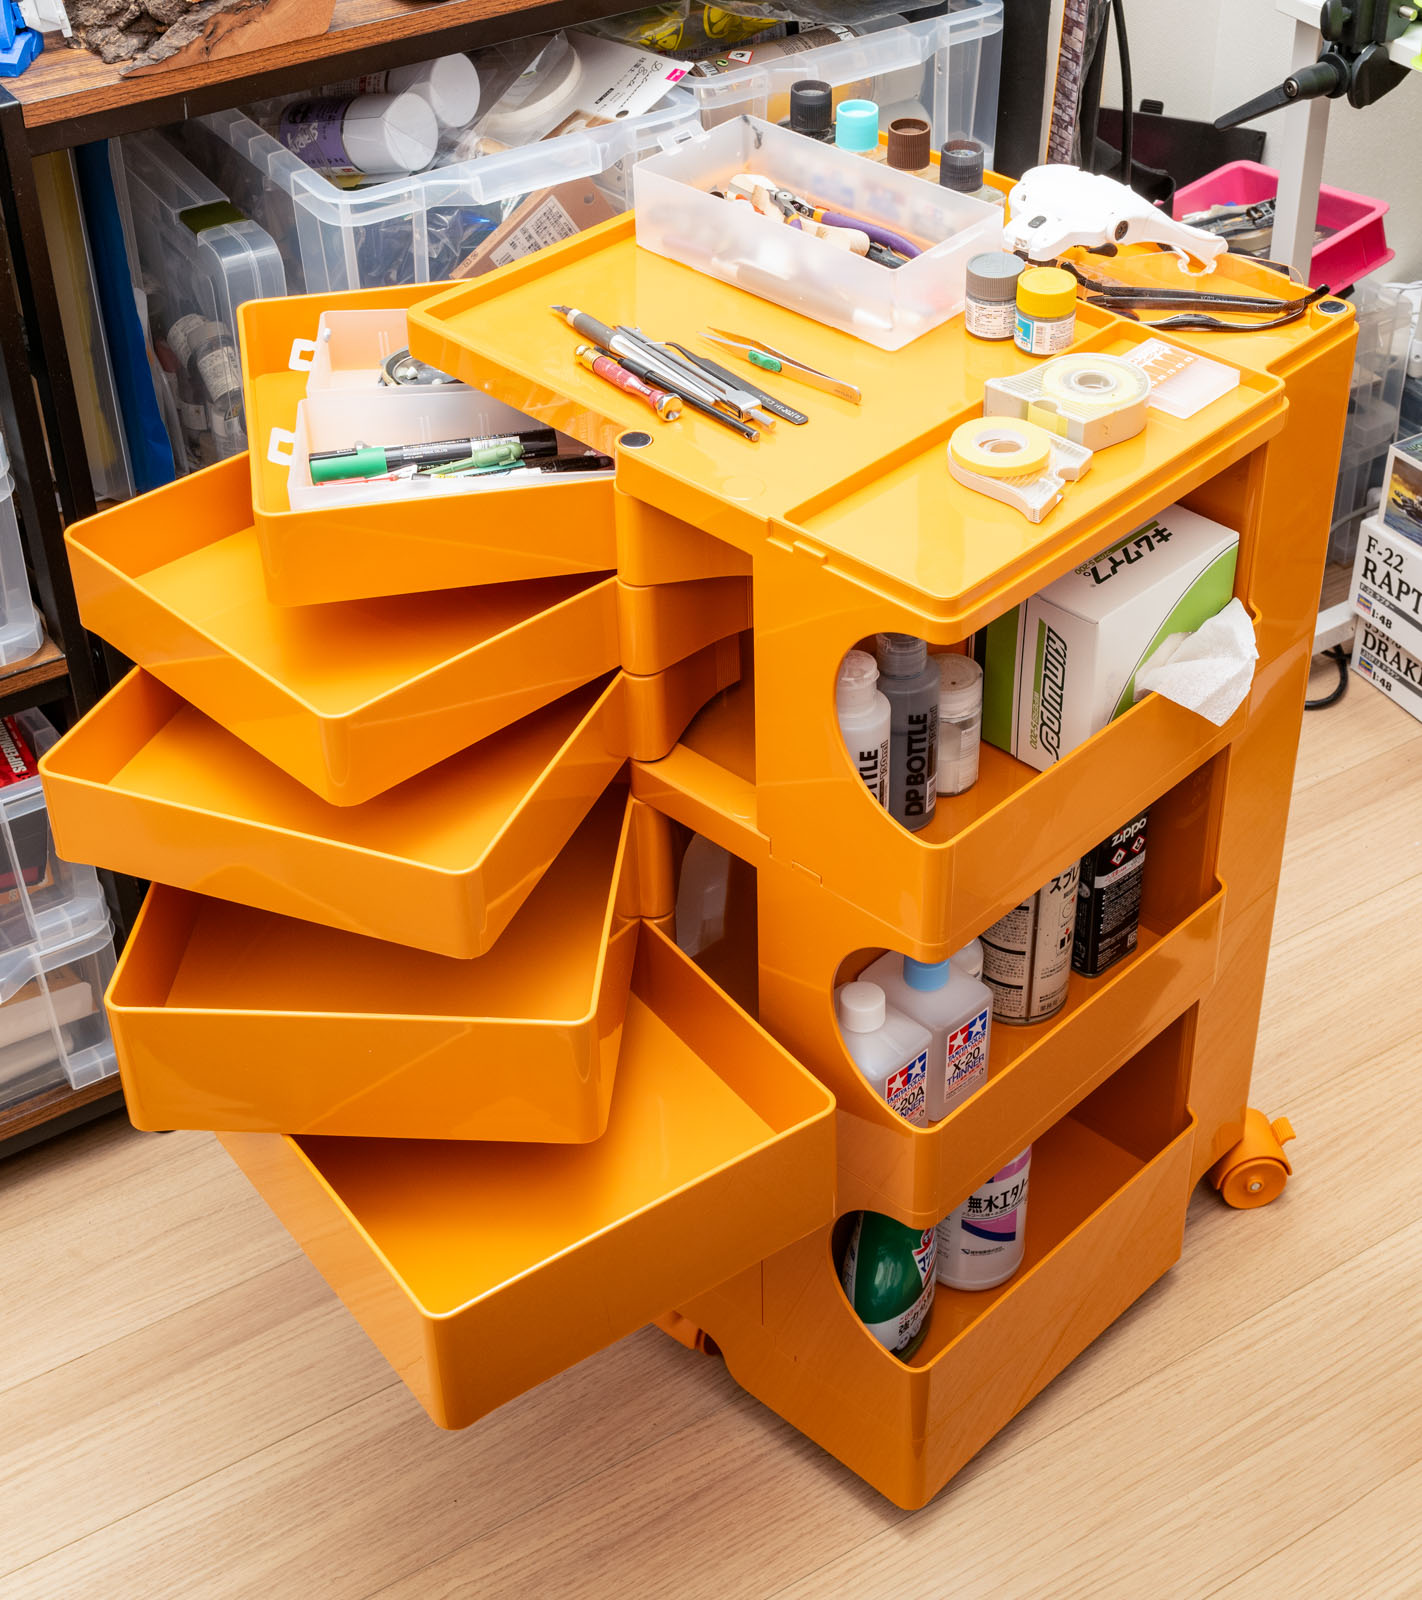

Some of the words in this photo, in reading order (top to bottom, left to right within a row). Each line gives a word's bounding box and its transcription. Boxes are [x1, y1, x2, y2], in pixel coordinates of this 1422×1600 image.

[1083, 526, 1173, 585] キムワイプ
[1366, 535, 1405, 574] F-22
[1371, 607, 1393, 630] 1:48
[1371, 670, 1393, 693] 1:48
[905, 713, 928, 787] BOTTLE
[905, 788, 925, 817] DP
[1111, 816, 1147, 848] zippo
[947, 1044, 968, 1063] TAMIYA
[967, 1030, 986, 1049] COLOR
[952, 1046, 980, 1077] X-20
[946, 1052, 985, 1086] THINNER
